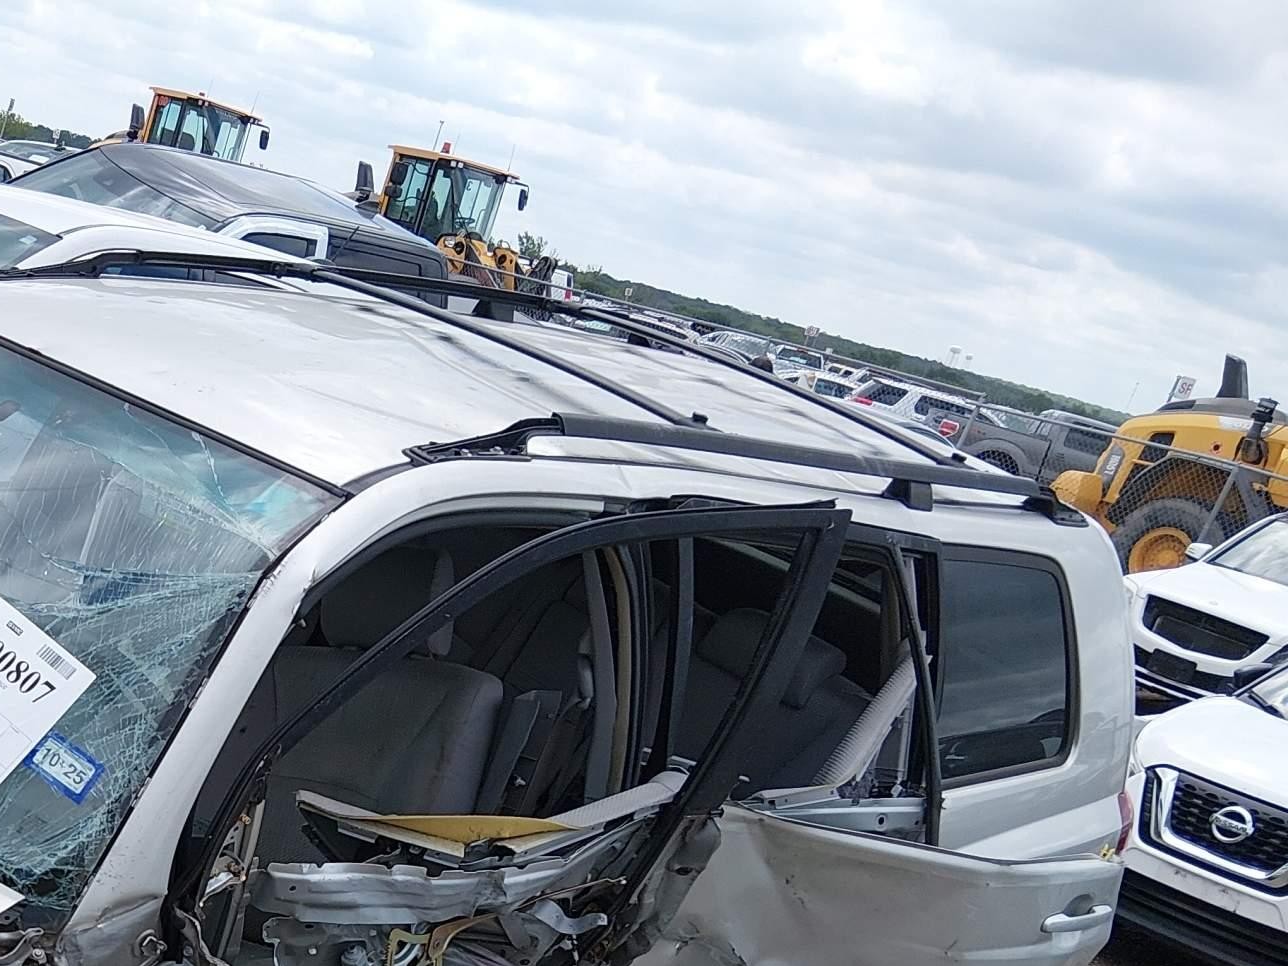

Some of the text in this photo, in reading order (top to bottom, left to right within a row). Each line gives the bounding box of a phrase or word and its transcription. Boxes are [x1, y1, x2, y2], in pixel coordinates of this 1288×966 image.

[41, 747, 87, 785] 10 25
[1214, 816, 1248, 833] NISSAN
